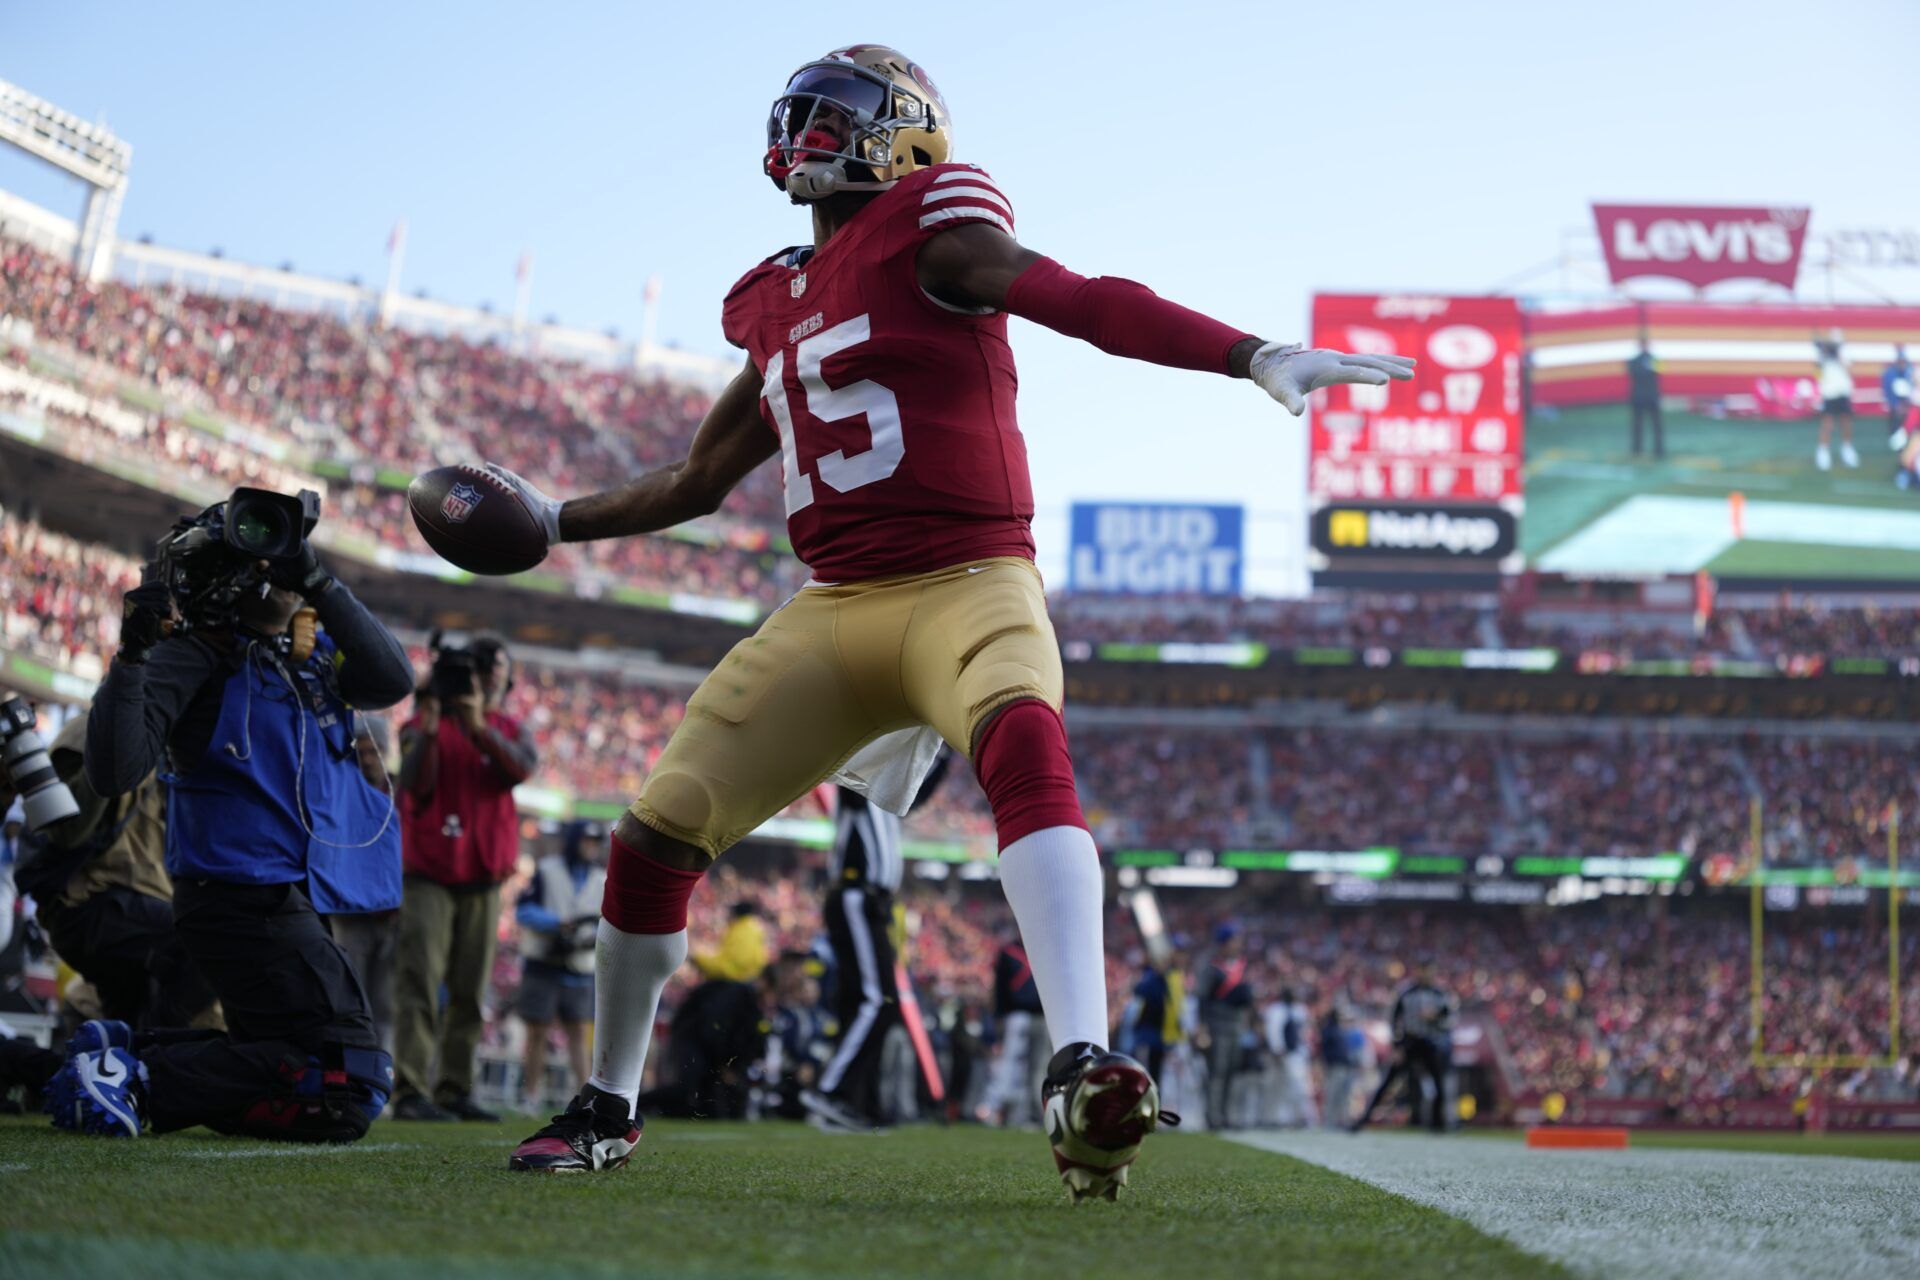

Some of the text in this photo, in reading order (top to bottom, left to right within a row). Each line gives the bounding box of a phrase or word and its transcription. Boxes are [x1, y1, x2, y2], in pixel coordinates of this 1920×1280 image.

[761, 313, 905, 519] 15
[443, 497, 469, 519] NFL
[1096, 507, 1218, 549] BUD
[1368, 510, 1500, 553] NetApp
[1074, 546, 1238, 593] LIGHT
